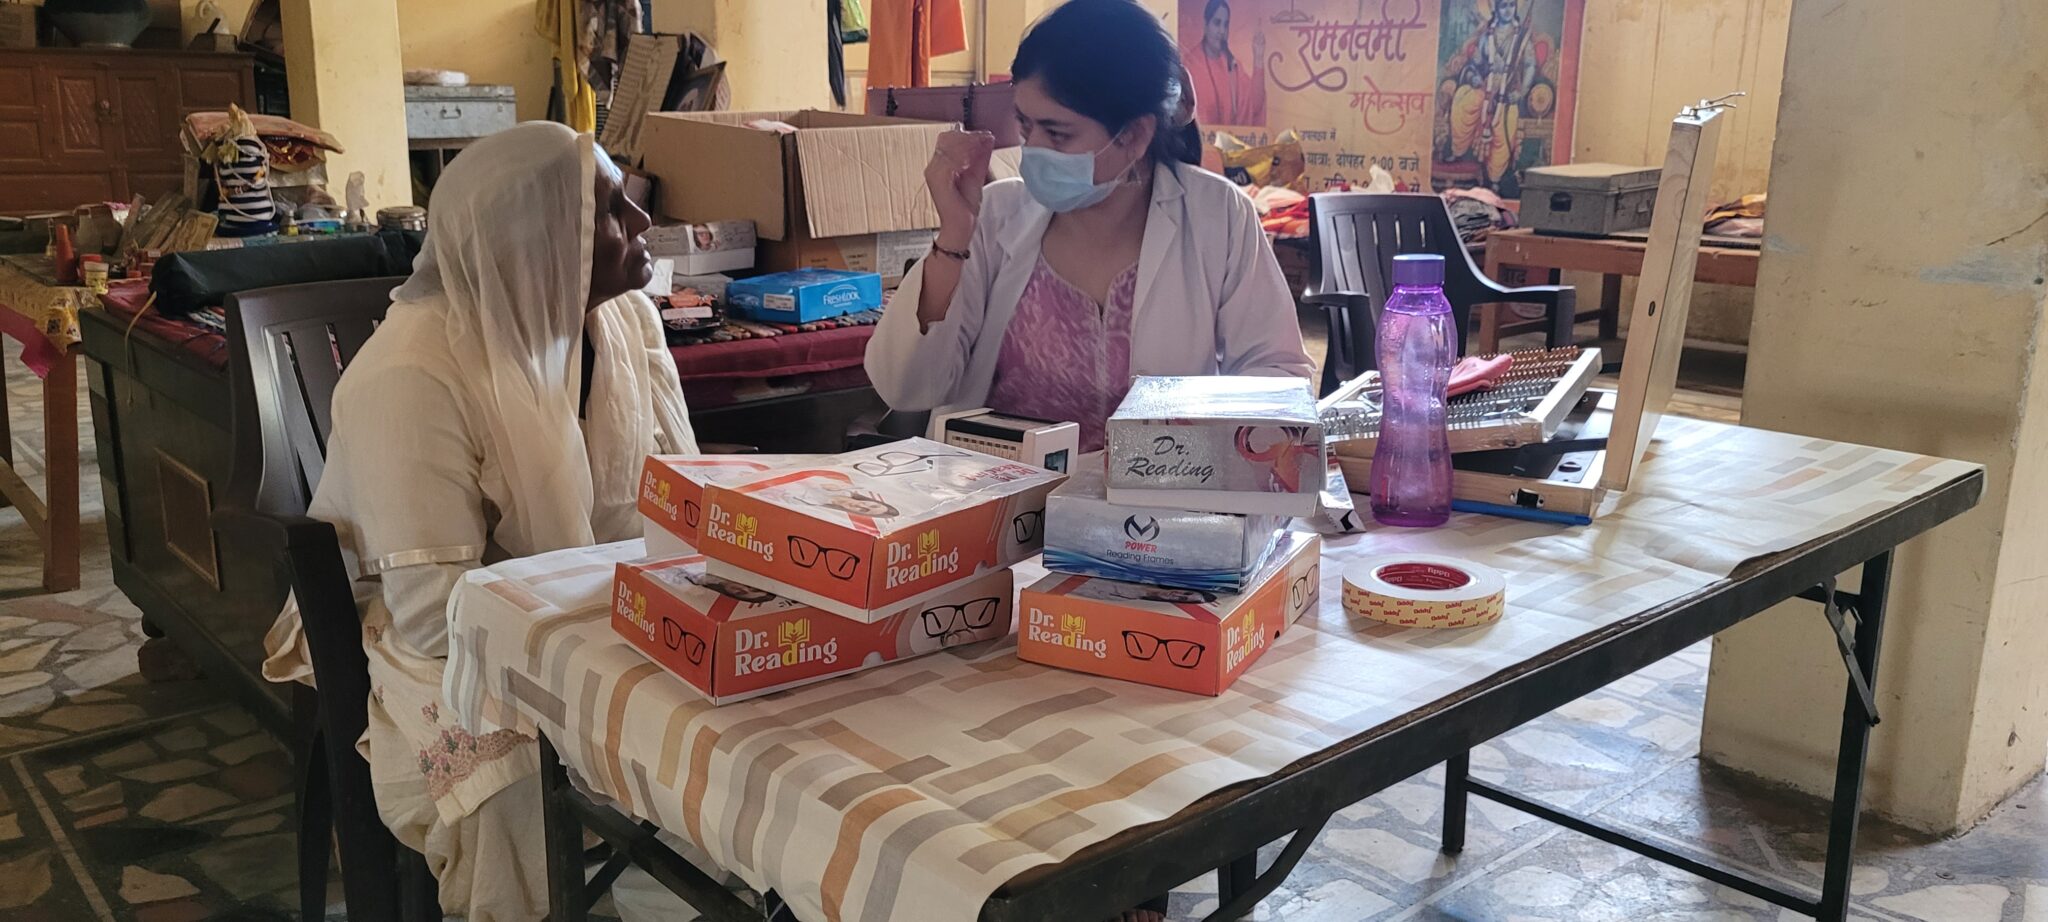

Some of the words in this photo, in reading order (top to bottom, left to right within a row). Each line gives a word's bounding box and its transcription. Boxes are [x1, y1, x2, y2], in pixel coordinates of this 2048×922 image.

[1335, 148, 1365, 169] दोपहर
[1398, 151, 1420, 171] बजे
[1153, 435, 1189, 456] Dr.
[645, 470, 657, 489] Dr.
[1125, 457, 1214, 484] Reading
[643, 484, 678, 521] Reading
[709, 503, 731, 526] Dr.
[707, 520, 774, 562] Reading
[887, 541, 912, 566] Dr.
[1125, 541, 1158, 553] POWER
[885, 546, 959, 590] Reading
[1106, 549, 1141, 563] Reading
[1143, 553, 1174, 565] Frames
[618, 580, 632, 603] Dr.
[616, 597, 655, 642] Reading
[1029, 607, 1054, 628] Dr.
[735, 629, 769, 653] Dr.
[1028, 624, 1107, 659] Reading
[1226, 622, 1265, 674] Reading
[1227, 626, 1240, 651] Dr.
[735, 637, 838, 677] Reading
